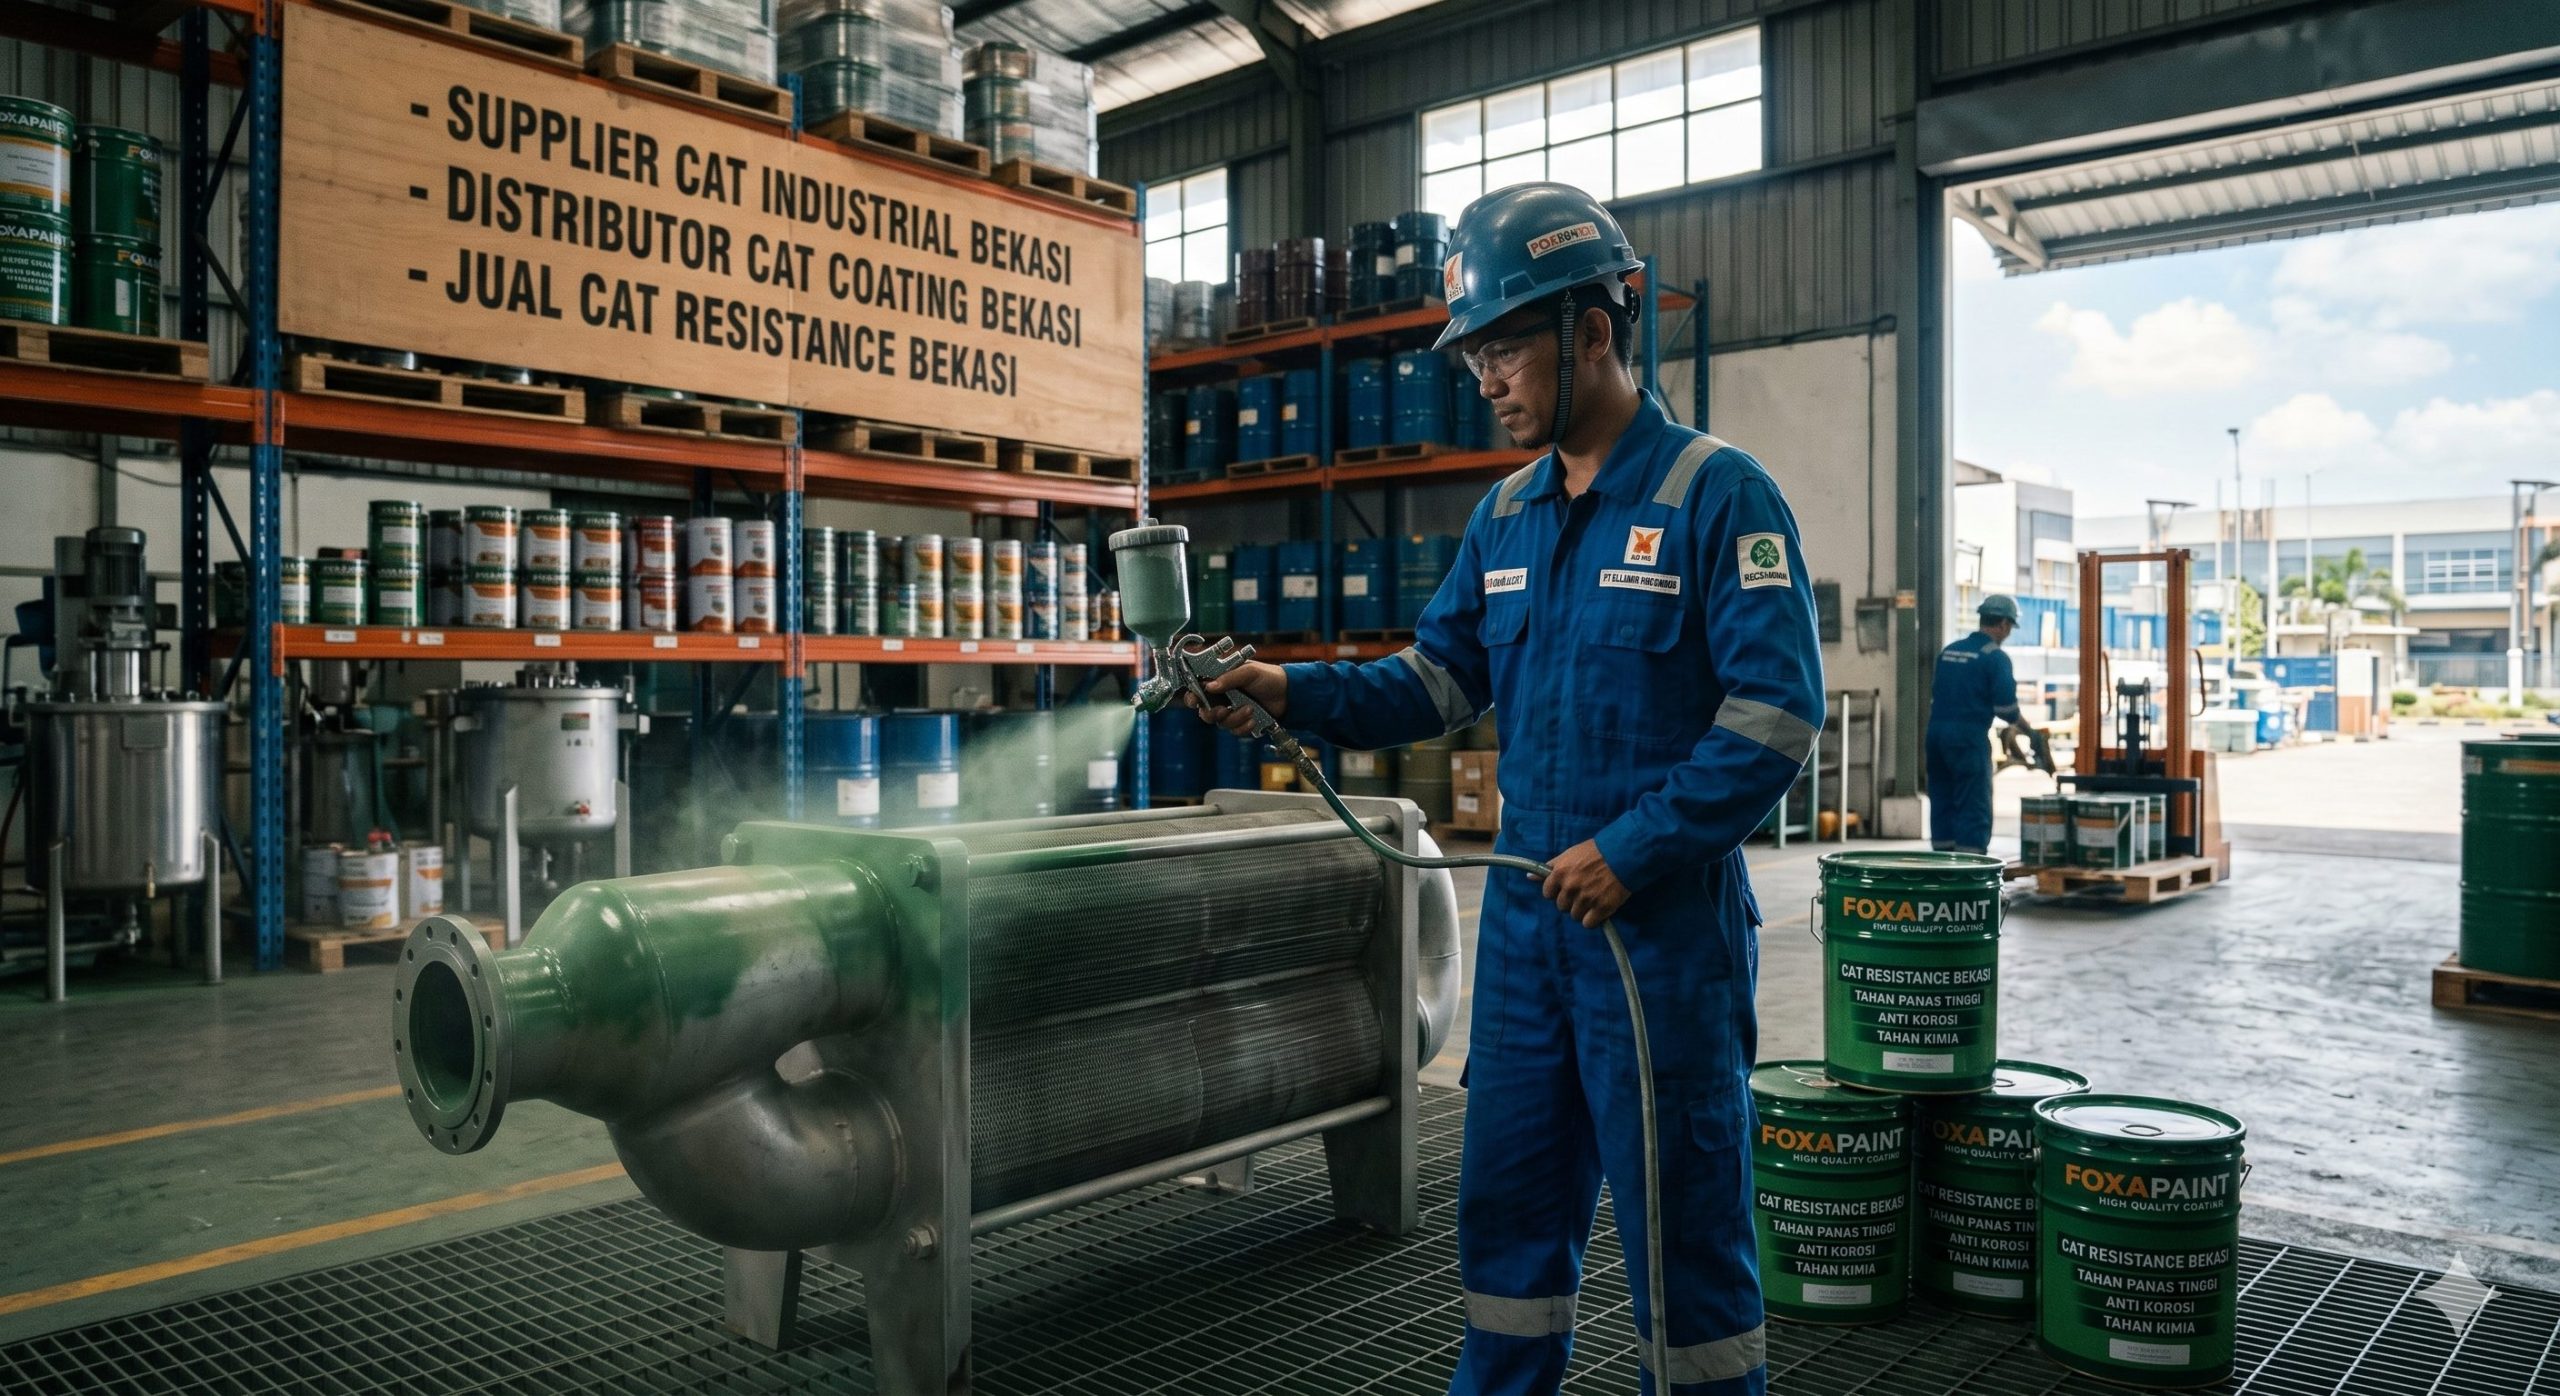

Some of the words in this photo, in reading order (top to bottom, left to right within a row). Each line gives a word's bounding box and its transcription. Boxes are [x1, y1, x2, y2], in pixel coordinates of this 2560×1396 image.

[447, 84, 659, 187] SUPPLIER
[676, 145, 747, 206] CAT
[762, 166, 959, 259] INDUSTRIAL
[971, 220, 1071, 286] BEKASI
[447, 166, 732, 276] DISTRIBUTOR
[748, 234, 814, 293] CAT
[829, 252, 968, 325] COATING
[981, 286, 1081, 348] BEKASI
[445, 248, 562, 320] JUAL
[580, 272, 660, 334] CAT
[675, 290, 896, 376] RESISTANCE
[910, 336, 1017, 397] BEKASI
[1843, 896, 1990, 922] FOXAPAINT
[1841, 964, 1863, 979] CAT
[1866, 967, 1950, 984] RESISTANCE
[1953, 967, 1990, 984] BEKASI
[1854, 989, 1894, 1005] TAHAN
[1898, 995, 1941, 1006] PANAS
[1945, 994, 1981, 1006] TINGGI
[1878, 1012, 1908, 1024] ANTI
[1912, 1014, 1958, 1025] KOROSI
[1877, 1030, 1920, 1044] TAHAN
[1924, 1033, 1959, 1044] KIMIA
[1762, 1124, 1905, 1153] FOXAPAINT
[1821, 1155, 1864, 1165] QUALITY
[1970, 1148, 2015, 1160] QUALITY
[2065, 1163, 2230, 1200] FOXAPAINT
[1759, 1193, 1781, 1208] CAT
[1784, 1198, 1867, 1216] RESISTANCE
[1917, 1180, 1937, 1197] CAT
[1938, 1187, 2022, 1210] RESISTANCE
[2098, 1196, 2127, 1209] HIGH
[2130, 1201, 2180, 1212] QUALITY
[1773, 1220, 1813, 1236] TAHAN
[1817, 1226, 1859, 1238] PANAS
[1862, 1222, 1896, 1237] TINGGI
[1928, 1207, 1965, 1226] TAHAN
[1967, 1217, 2011, 1232] PANAS
[1797, 1243, 1827, 1256] ANTI
[1831, 1244, 1876, 1257] KOROSI
[1949, 1232, 1978, 1247] ANTI
[1981, 1238, 2030, 1251] KOROSI
[1947, 1249, 1989, 1267] TAHAN
[1992, 1257, 2030, 1270] KIMIA
[2061, 1238, 2086, 1257] CAT
[2089, 1245, 2184, 1269] RESISTANCE
[2188, 1248, 2229, 1268] BEKASI
[1795, 1261, 1838, 1275] TAHAN
[1841, 1264, 1876, 1275] KIMIA
[2077, 1268, 2122, 1289] TAHAN
[2127, 1278, 2174, 1293] PANAS
[2178, 1278, 2217, 1293] TINGGI
[2105, 1296, 2139, 1313] ANTI
[2144, 1301, 2195, 1314] KOROSI
[2103, 1315, 2152, 1333] TAHAN
[2156, 1321, 2196, 1334] KIMIA
